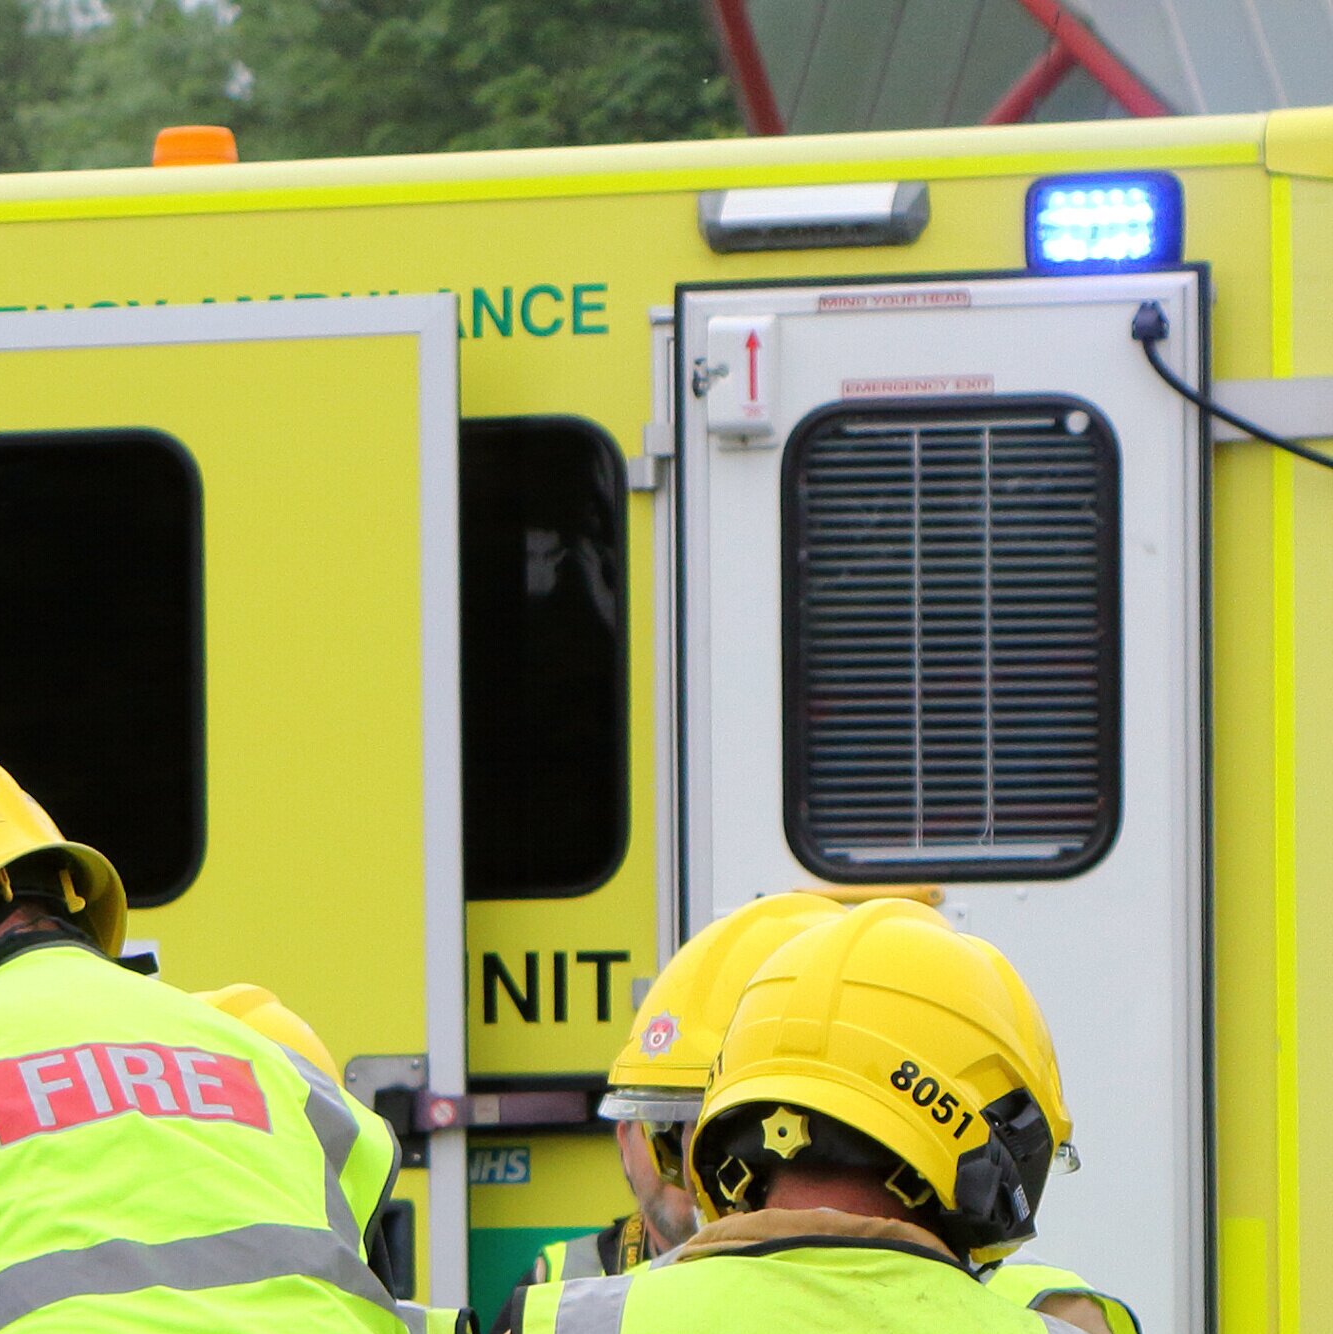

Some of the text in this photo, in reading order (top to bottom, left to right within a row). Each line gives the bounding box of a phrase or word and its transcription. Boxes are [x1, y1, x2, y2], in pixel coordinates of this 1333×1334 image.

[873, 295, 917, 305] YOUR
[845, 378, 990, 393] EMERGENCY EXIT
[464, 950, 630, 1024] NIT
[18, 1046, 234, 1127] FIRE
[890, 1060, 974, 1140] 8051
